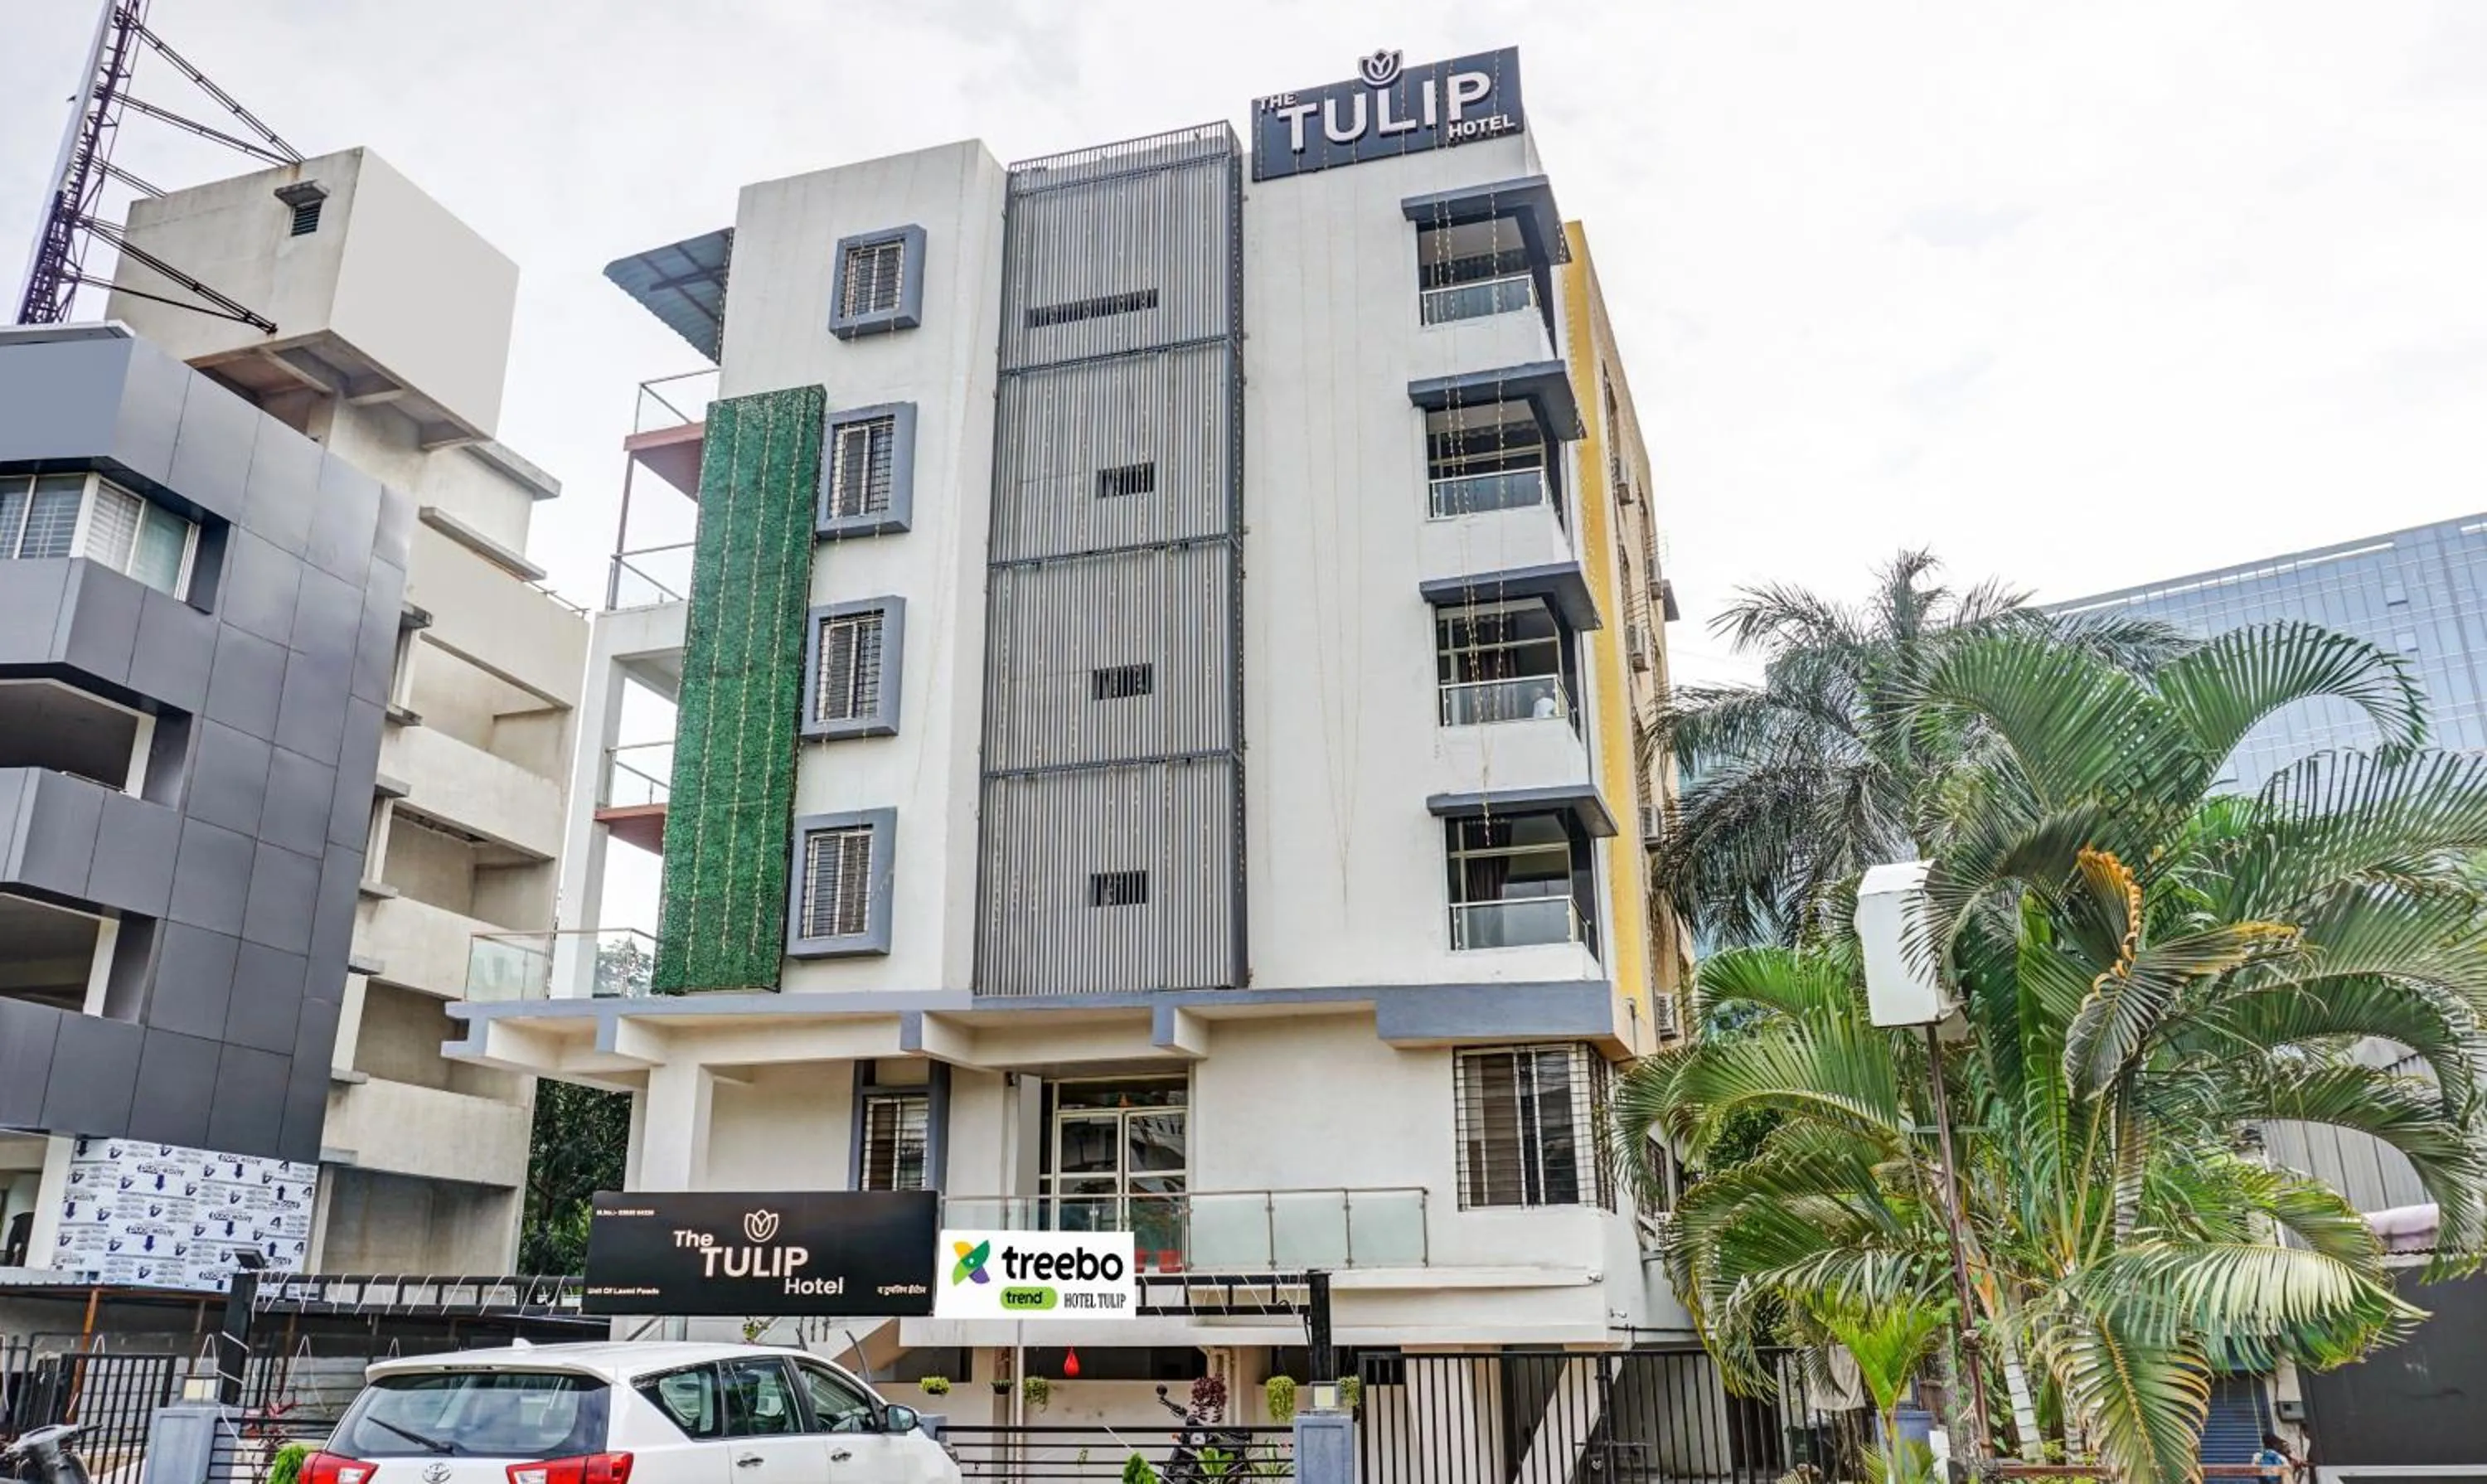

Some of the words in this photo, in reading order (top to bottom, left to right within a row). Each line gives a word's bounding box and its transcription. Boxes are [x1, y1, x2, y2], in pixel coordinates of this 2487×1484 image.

[1259, 92, 1296, 109] THE
[1277, 72, 1491, 151] TULIP
[1448, 114, 1515, 137] HOTEL
[673, 1230, 714, 1247] The
[700, 1247, 808, 1277] TULIP
[1001, 1246, 1123, 1281] treebo
[784, 1277, 844, 1294] Hotel
[1006, 1291, 1043, 1304] trend
[1064, 1292, 1096, 1309] HOTEL
[1098, 1292, 1127, 1309] TULIP
